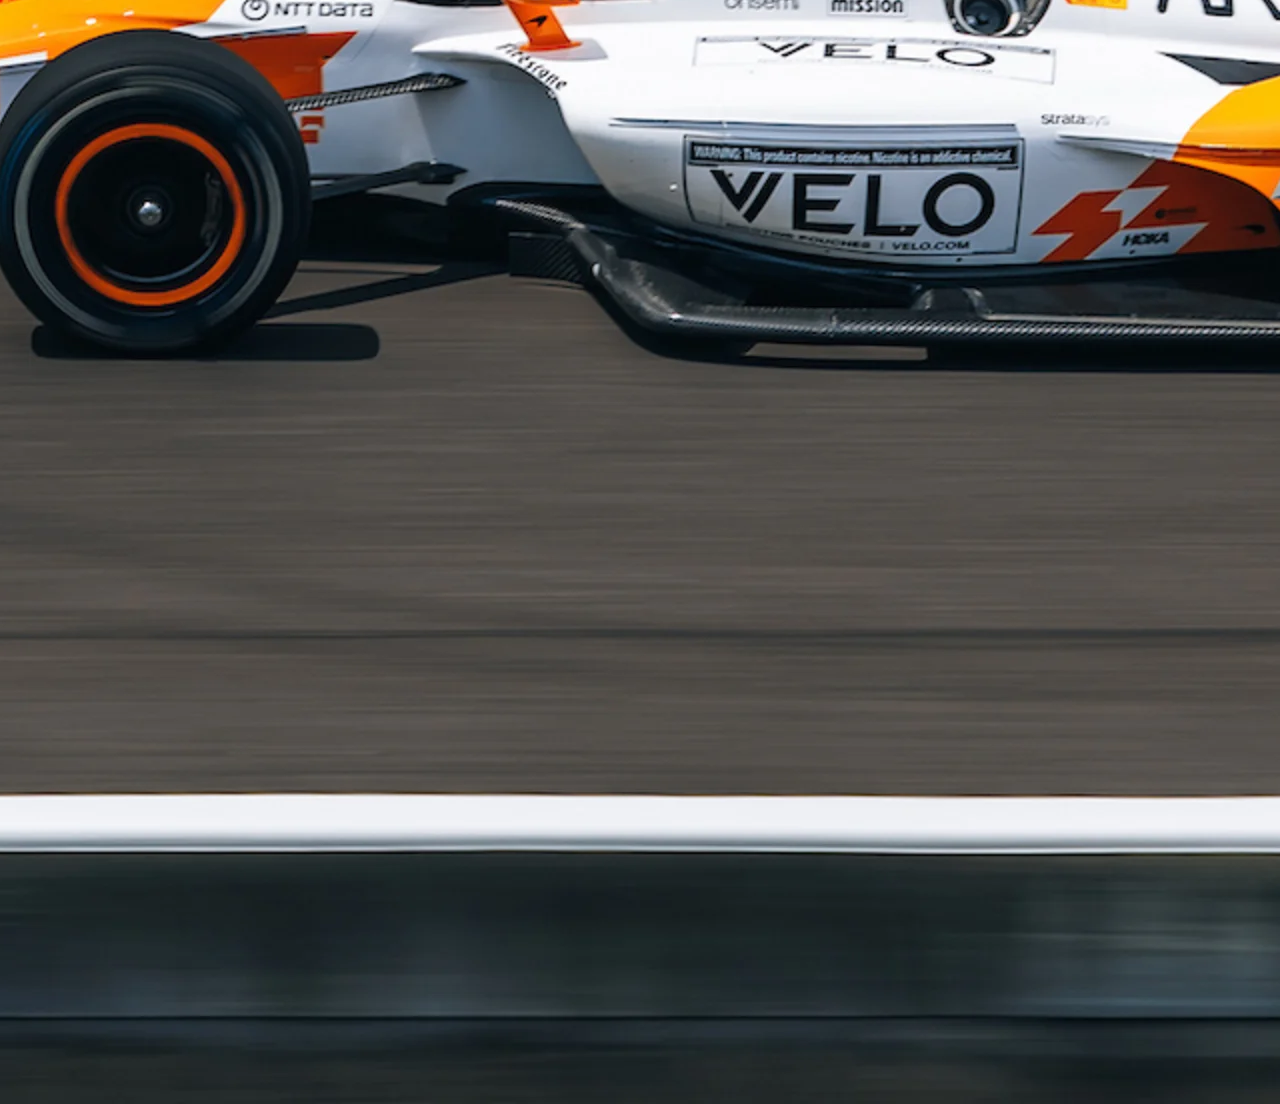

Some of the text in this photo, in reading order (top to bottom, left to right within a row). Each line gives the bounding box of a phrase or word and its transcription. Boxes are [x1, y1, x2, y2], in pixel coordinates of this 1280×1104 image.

[273, 1, 315, 17] NTT
[758, 40, 996, 67] VELO
[495, 42, 568, 91] Firestone
[1040, 113, 1111, 128] stratasys
[743, 147, 763, 161] This
[763, 149, 797, 164] product
[709, 169, 996, 237] VELO
[891, 240, 970, 251] VELO.COM
[1121, 231, 1170, 247] HOKA
